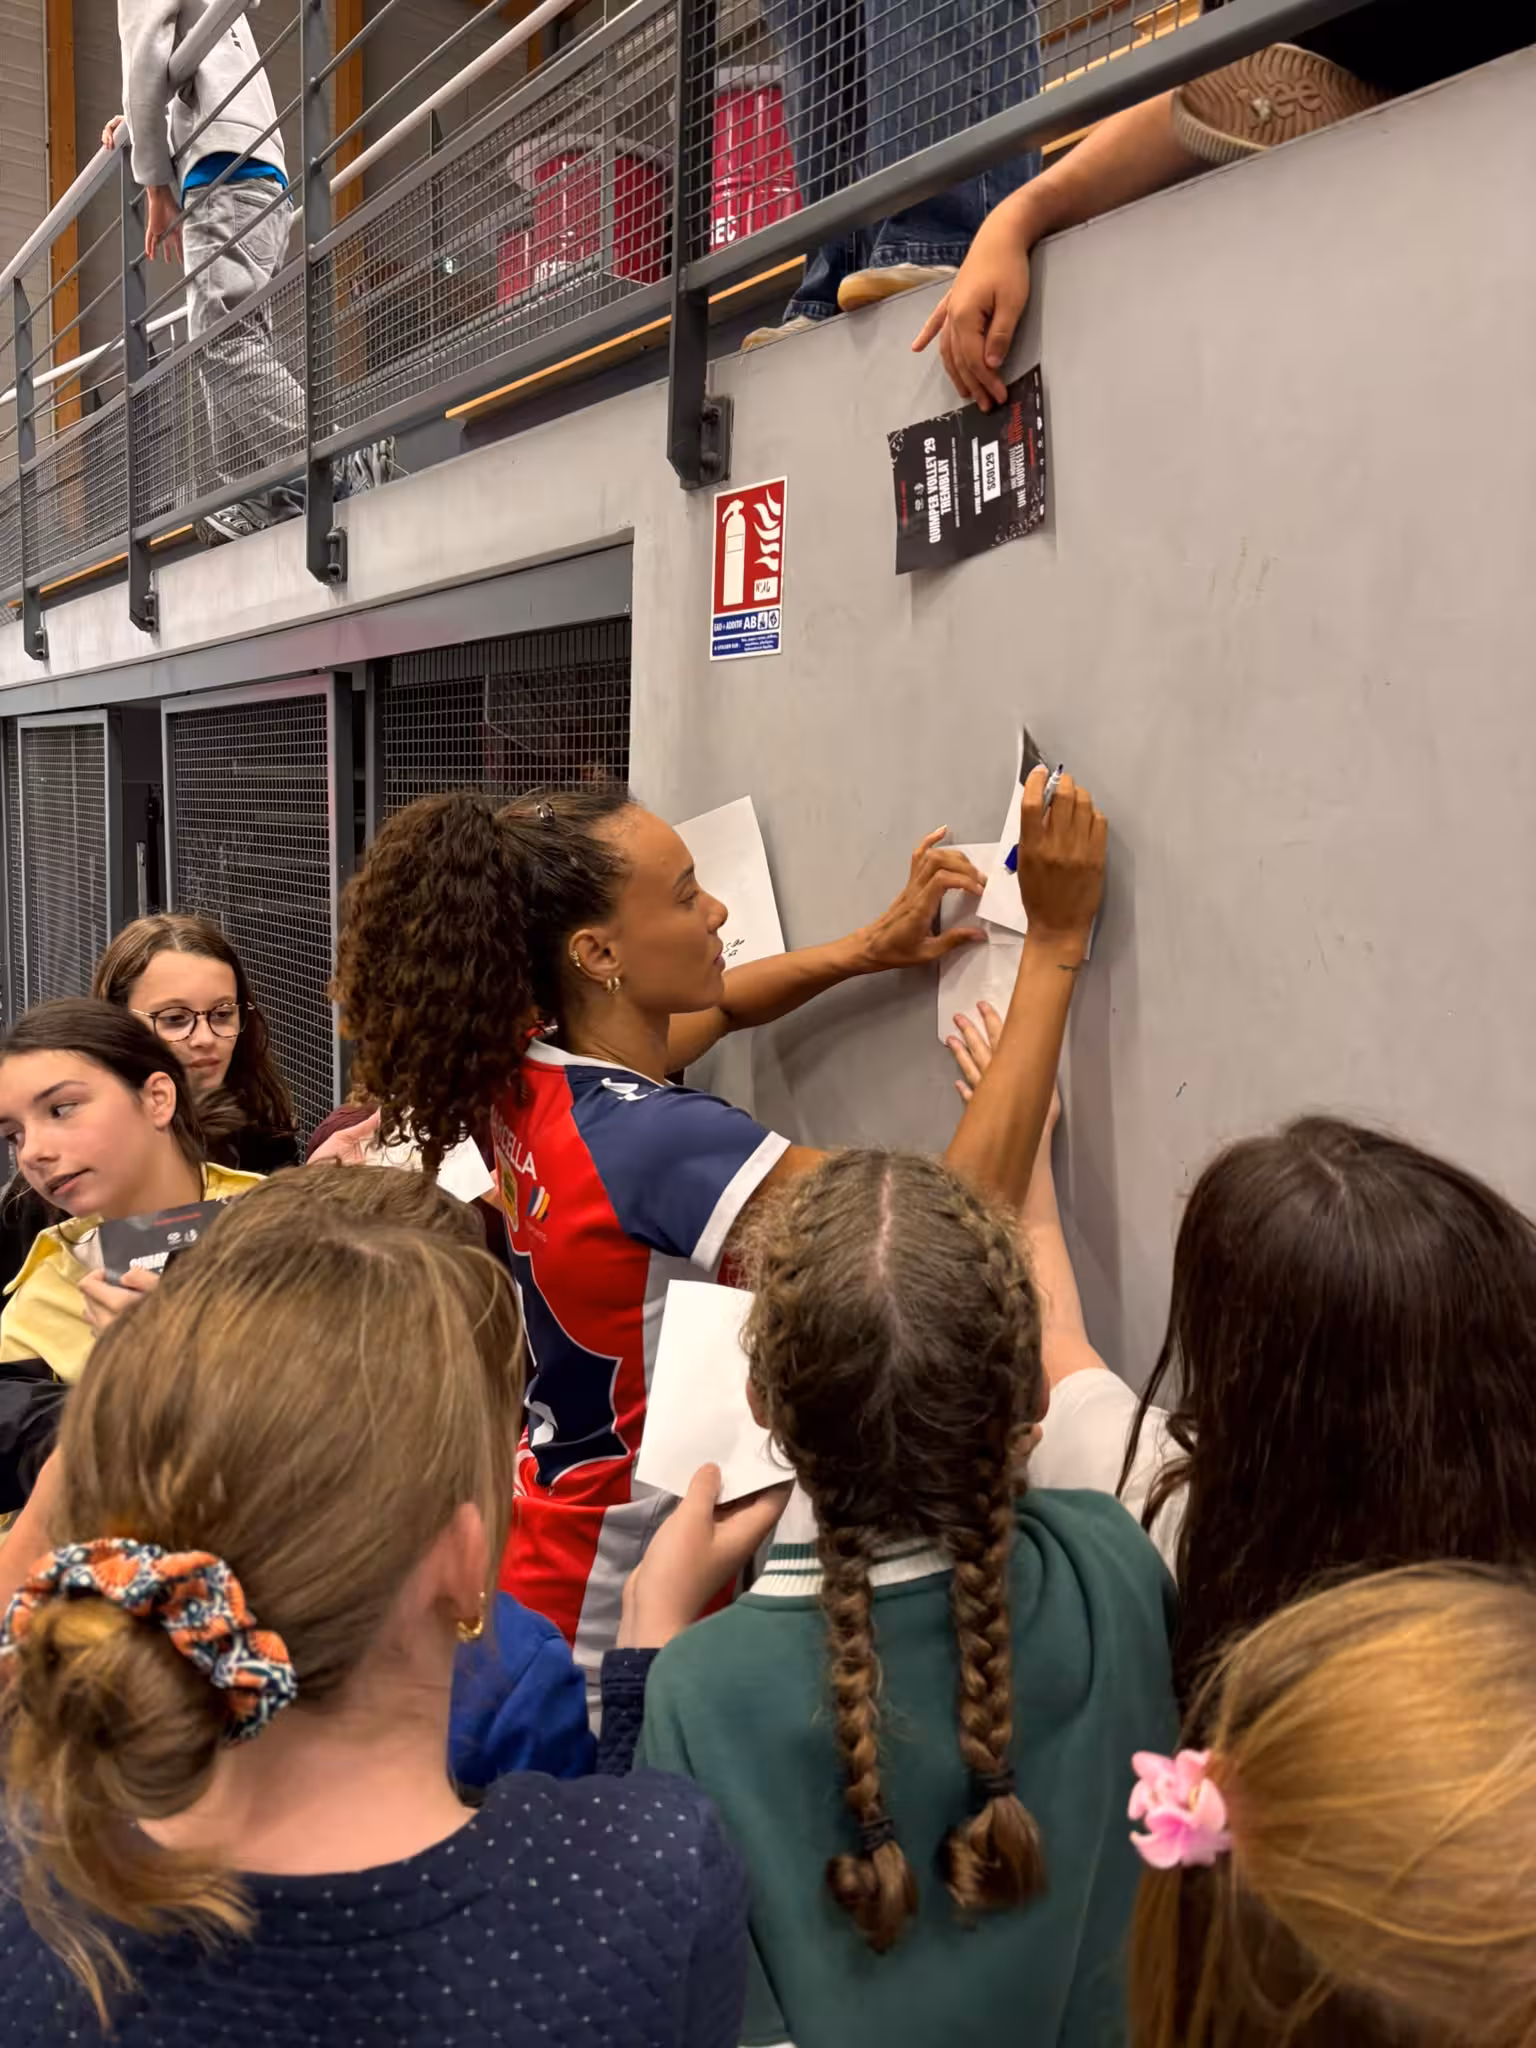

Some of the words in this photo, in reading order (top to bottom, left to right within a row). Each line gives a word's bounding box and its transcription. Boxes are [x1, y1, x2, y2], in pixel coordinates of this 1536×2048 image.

[924, 437, 936, 454] 29
[1015, 442, 1025, 487] NOUVELLE
[926, 455, 937, 494] VOLLEY
[938, 459, 951, 515] TREMBLAY
[986, 452, 996, 491] SCOL29
[1017, 488, 1026, 507] UNE
[928, 494, 941, 544] QUIMPER
[744, 616, 756, 630] AB
